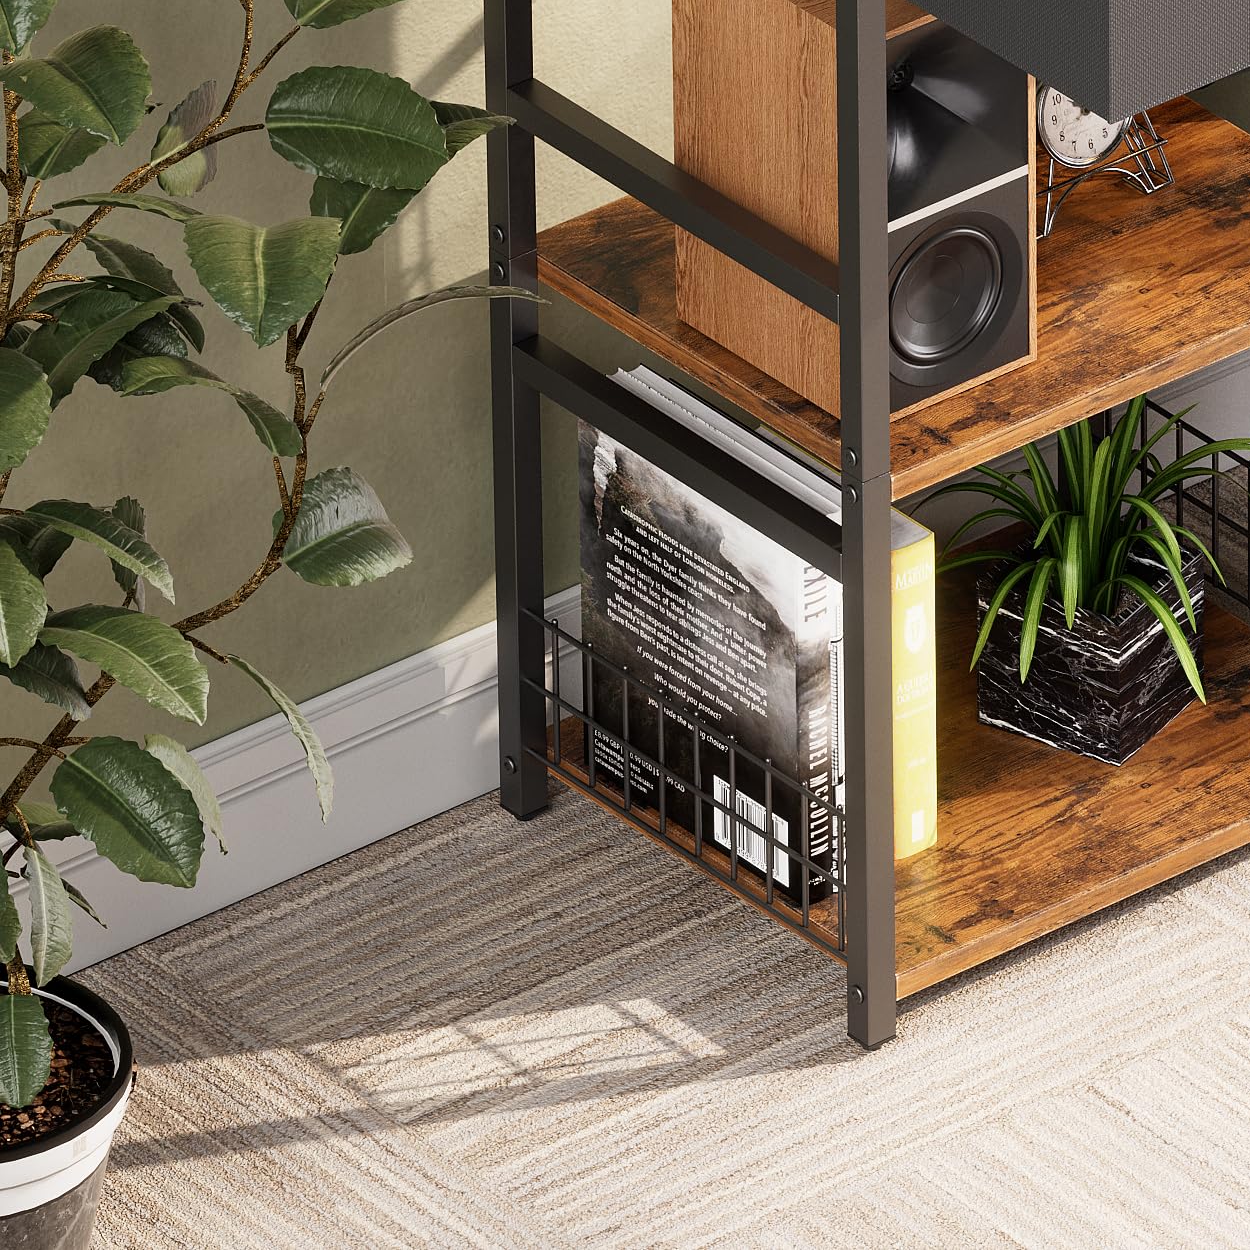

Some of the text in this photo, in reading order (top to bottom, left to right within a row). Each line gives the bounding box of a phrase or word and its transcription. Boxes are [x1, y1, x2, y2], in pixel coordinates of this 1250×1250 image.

[1052, 94, 1061, 106] 10
[1052, 115, 1057, 125] 9
[1102, 128, 1108, 138] 5
[1059, 130, 1065, 141] 8
[1072, 140, 1077, 152] 7
[1088, 139, 1094, 149] 6
[605, 533, 703, 601] safety on the North Yorkshire coast.
[613, 527, 765, 630] Six years on, the Dyer family thinks they have found
[606, 561, 622, 575] north
[623, 572, 635, 584] and
[637, 580, 646, 591] the
[649, 587, 660, 600] loss
[662, 597, 668, 605] of
[670, 602, 684, 615] their
[686, 612, 709, 632] mother.
[710, 627, 722, 640] And
[730, 639, 746, 655] bitter
[748, 652, 766, 668] power
[606, 571, 757, 672] struggle threatens to tear siblings Jess and Ben apart.
[614, 554, 766, 659] But the family is haunted by memories of the journey
[606, 598, 616, 609] the
[617, 603, 639, 624] family's
[640, 619, 656, 635] worst
[657, 631, 686, 654] nightmare
[687, 650, 693, 659] to
[694, 654, 708, 668] their
[709, 664, 724, 679] door.
[725, 673, 744, 692] Robert
[745, 687, 762, 704] Cope,
[607, 607, 767, 717] figure from Ben's past, is intent on revenge at any price.
[614, 592, 632, 609] When
[632, 604, 645, 617] Jess
[646, 614, 672, 635] responds
[672, 630, 678, 639] to
[684, 637, 706, 657] distress
[706, 653, 717, 664] call
[717, 660, 723, 668] at
[724, 664, 736, 677] sea,
[736, 671, 747, 683] she
[748, 677, 766, 696] brings
[636, 645, 737, 715] If you were forced from your home...
[654, 672, 721, 720] Who would you protect?
[706, 735, 728, 753] choice?
[809, 705, 828, 770] RACHEL
